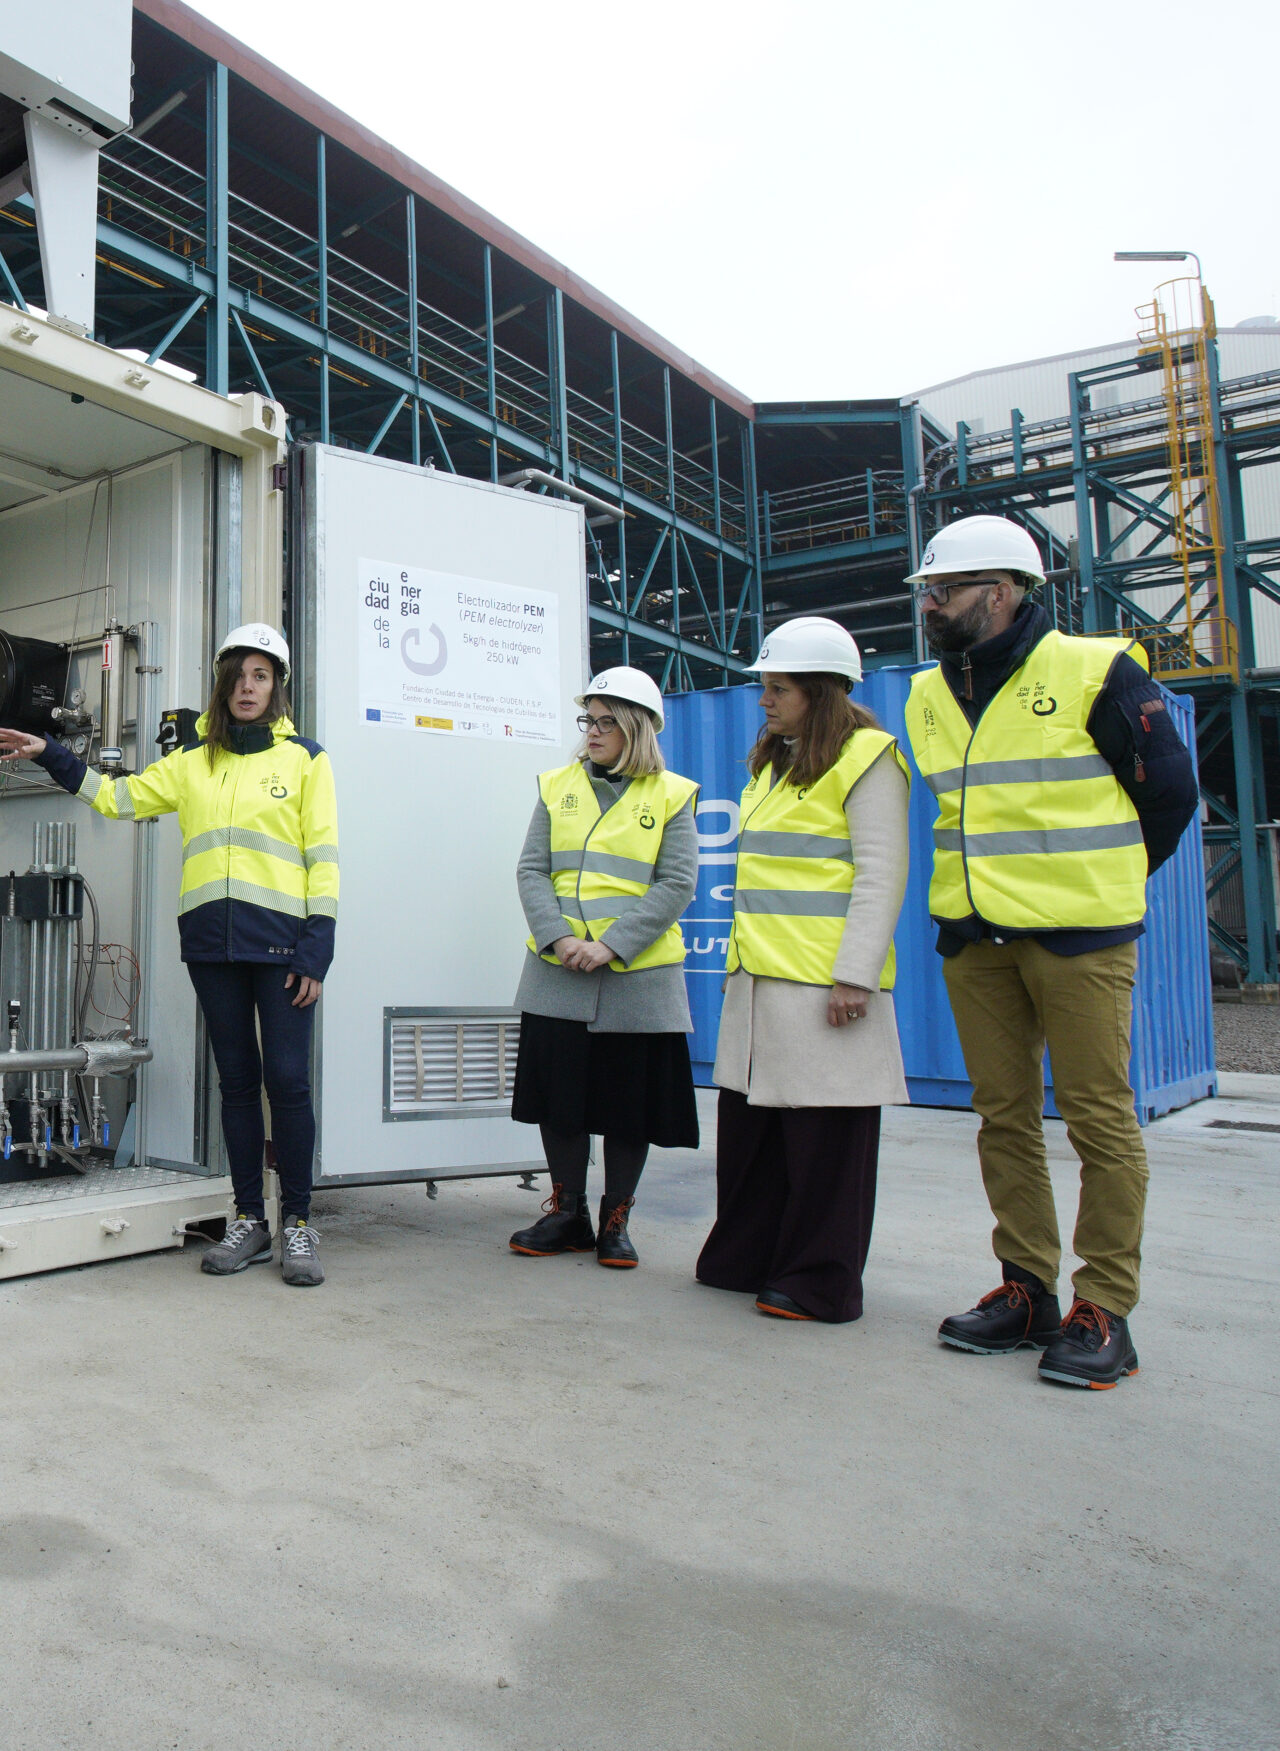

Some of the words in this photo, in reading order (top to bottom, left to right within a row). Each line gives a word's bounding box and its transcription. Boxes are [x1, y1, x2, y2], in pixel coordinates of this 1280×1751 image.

[369, 577, 389, 593] ciu
[401, 585, 422, 599] ner
[365, 592, 390, 610] dad
[400, 599, 420, 617] gía
[457, 592, 520, 614] Electrolizador
[523, 604, 545, 618] PEM
[373, 615, 390, 632] de
[459, 609, 487, 624] (PEM
[488, 615, 544, 636] electrolyzer)
[379, 632, 390, 649] la
[463, 632, 487, 648] 5kg/h
[489, 638, 500, 648] de
[502, 640, 542, 655] hidrógeno
[486, 651, 505, 664] 250
[506, 654, 520, 666] kW
[402, 683, 434, 695] Fundación
[435, 687, 456, 698] Ciudad
[457, 691, 465, 699] de
[402, 693, 423, 703] Centro
[424, 697, 432, 705] de
[433, 698, 462, 708] Desarrollo
[506, 707, 514, 715] de
